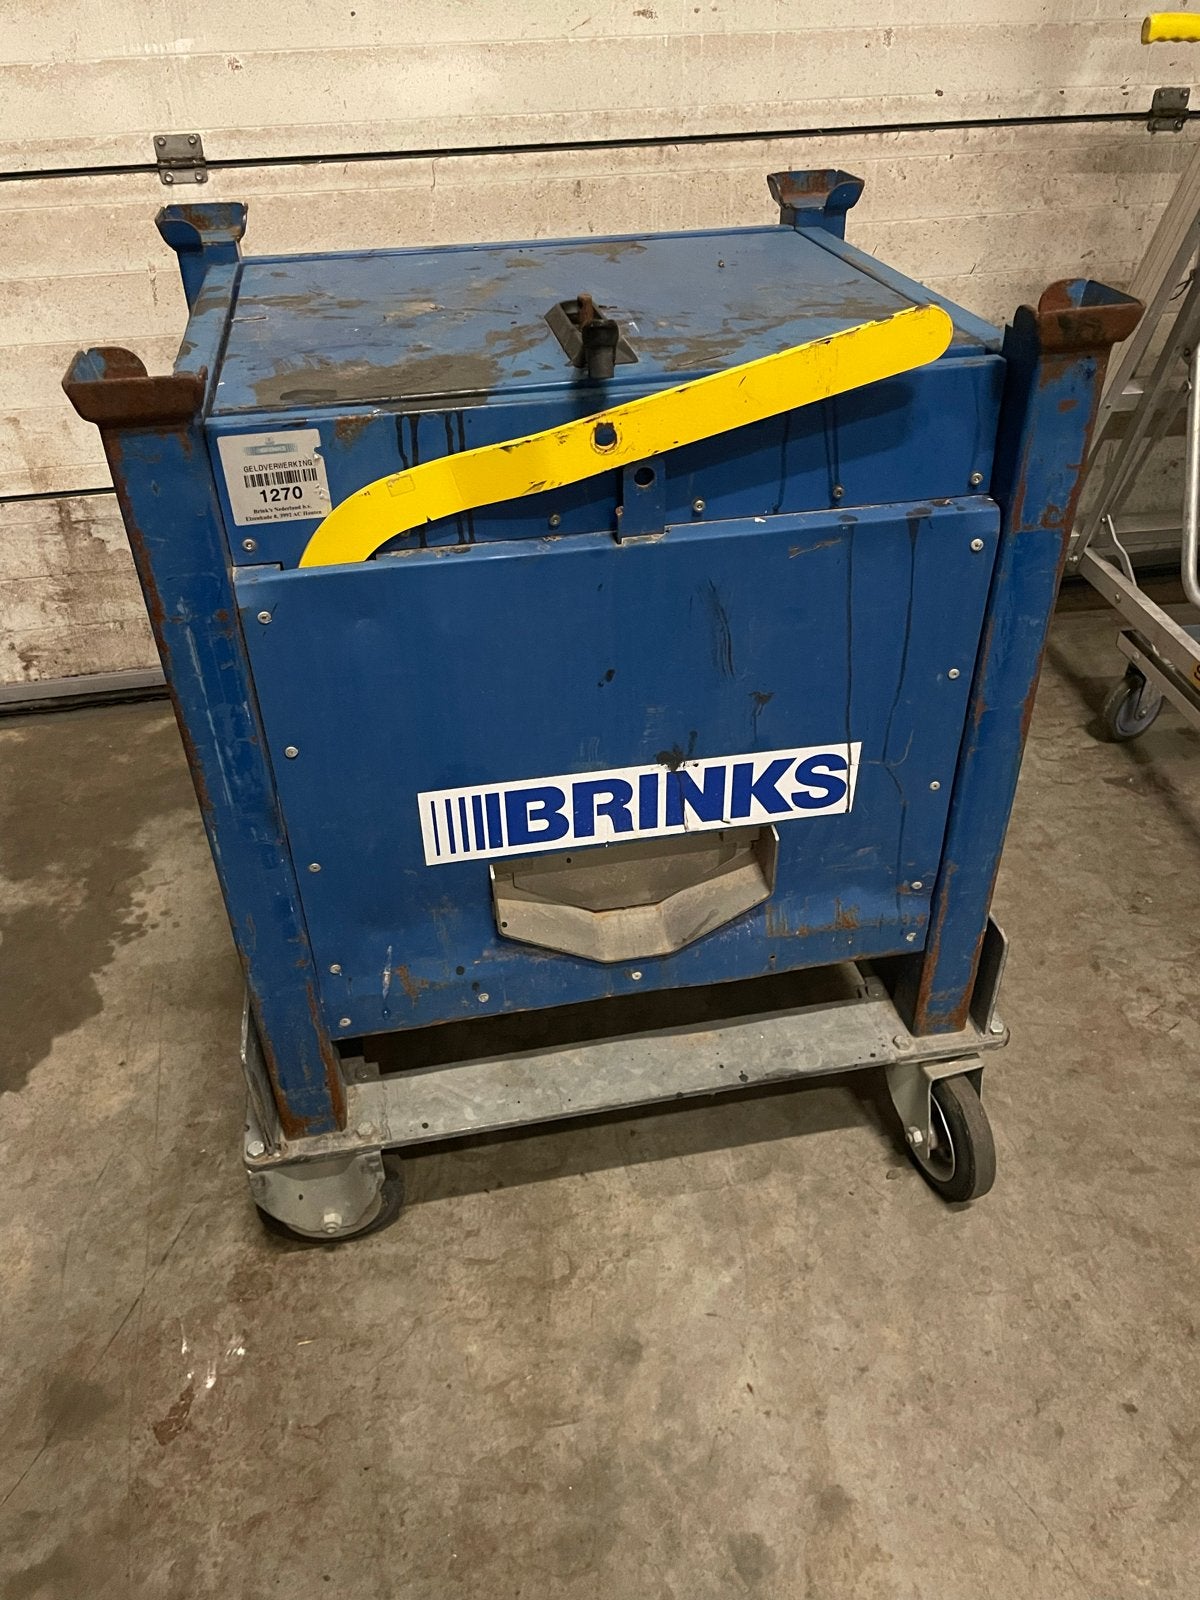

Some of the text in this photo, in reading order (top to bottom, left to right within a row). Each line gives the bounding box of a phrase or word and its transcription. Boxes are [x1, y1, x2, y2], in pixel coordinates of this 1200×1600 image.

[243, 459, 313, 473] GELDVERWERKING
[259, 486, 303, 503] 1270
[504, 753, 847, 847] BRINKS
